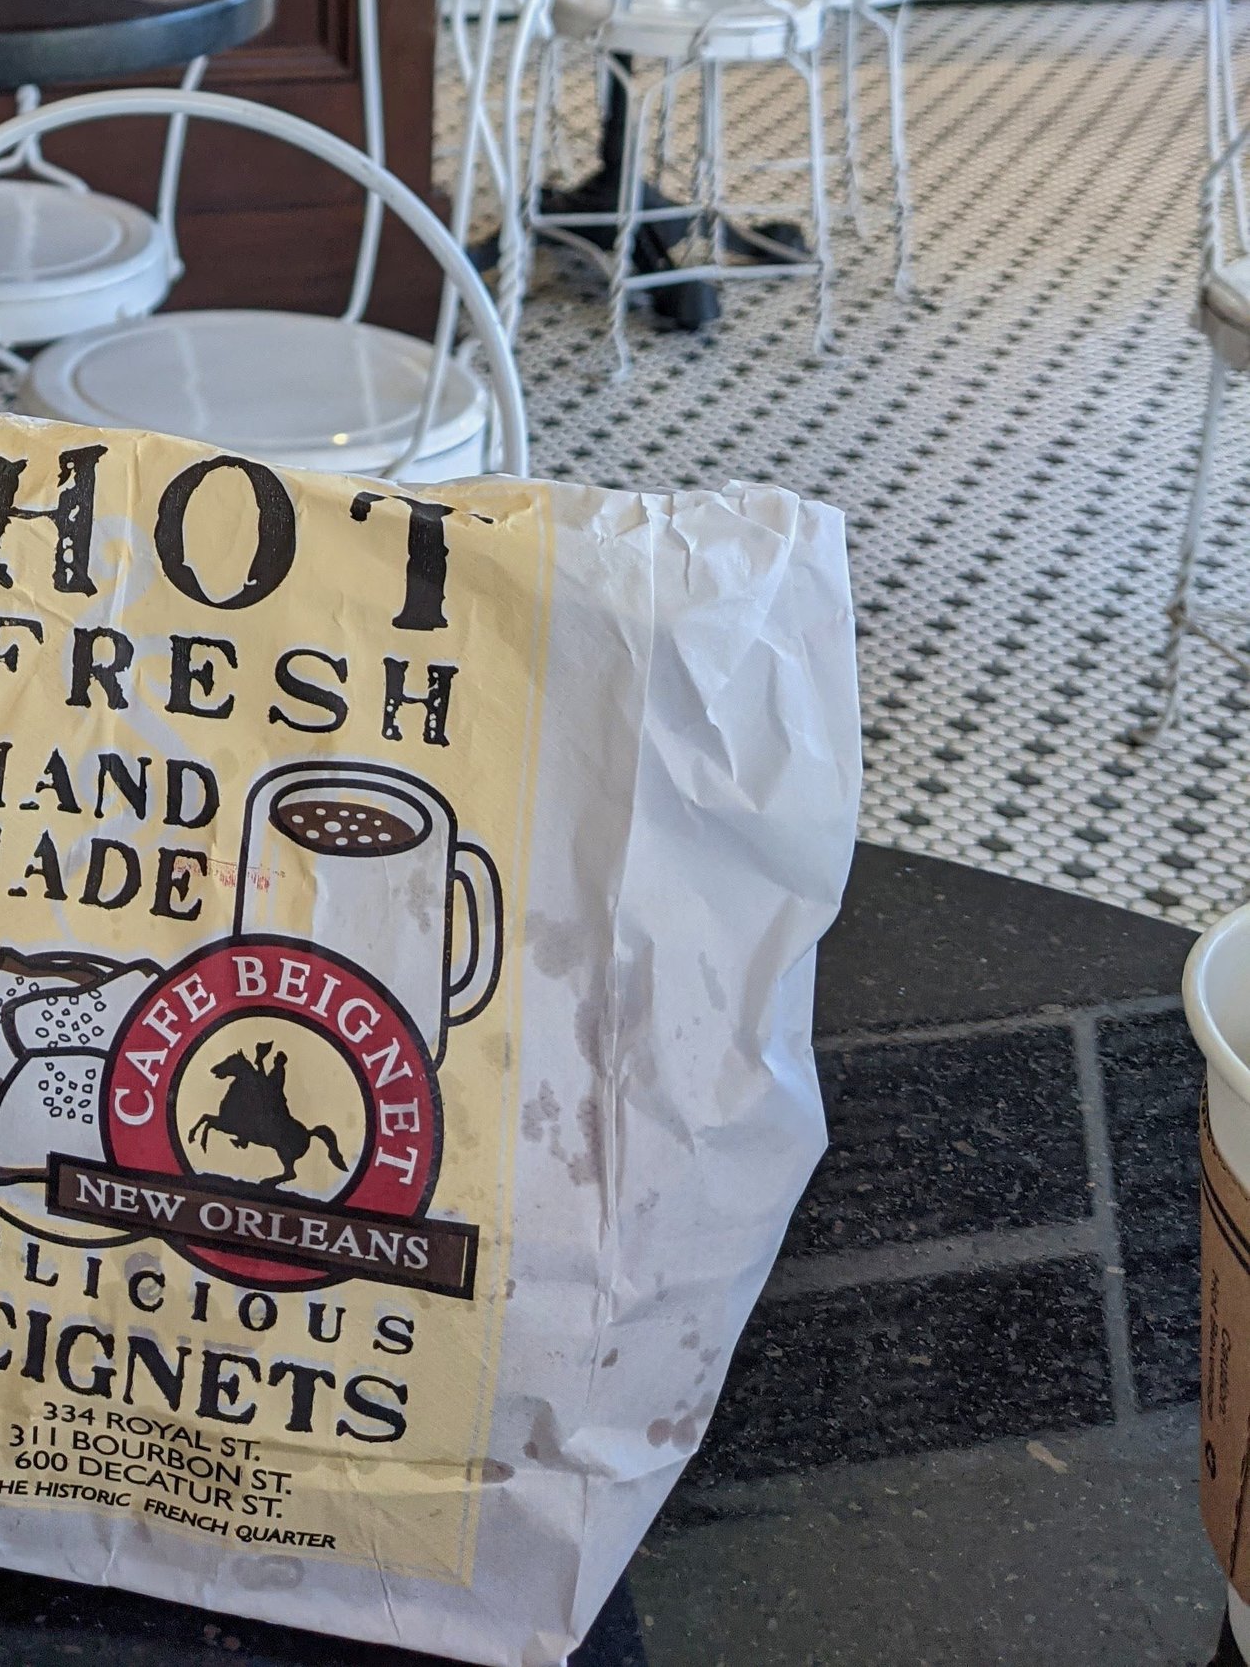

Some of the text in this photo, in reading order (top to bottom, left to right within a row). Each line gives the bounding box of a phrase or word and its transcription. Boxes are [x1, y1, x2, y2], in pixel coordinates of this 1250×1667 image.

[114, 955, 421, 1185] CAFE BEIGNET
[75, 1174, 429, 1270] NEW ORLEANS
[8, 1424, 293, 1495] 311 BOURBON ST.
[42, 1401, 262, 1461] 334 ROYAL ST.
[14, 1450, 284, 1519] 600 DECATUR ST.
[34, 1480, 132, 1508] HISTORIC
[142, 1497, 230, 1536] FRENCH
[234, 1524, 337, 1551] QUARTER
